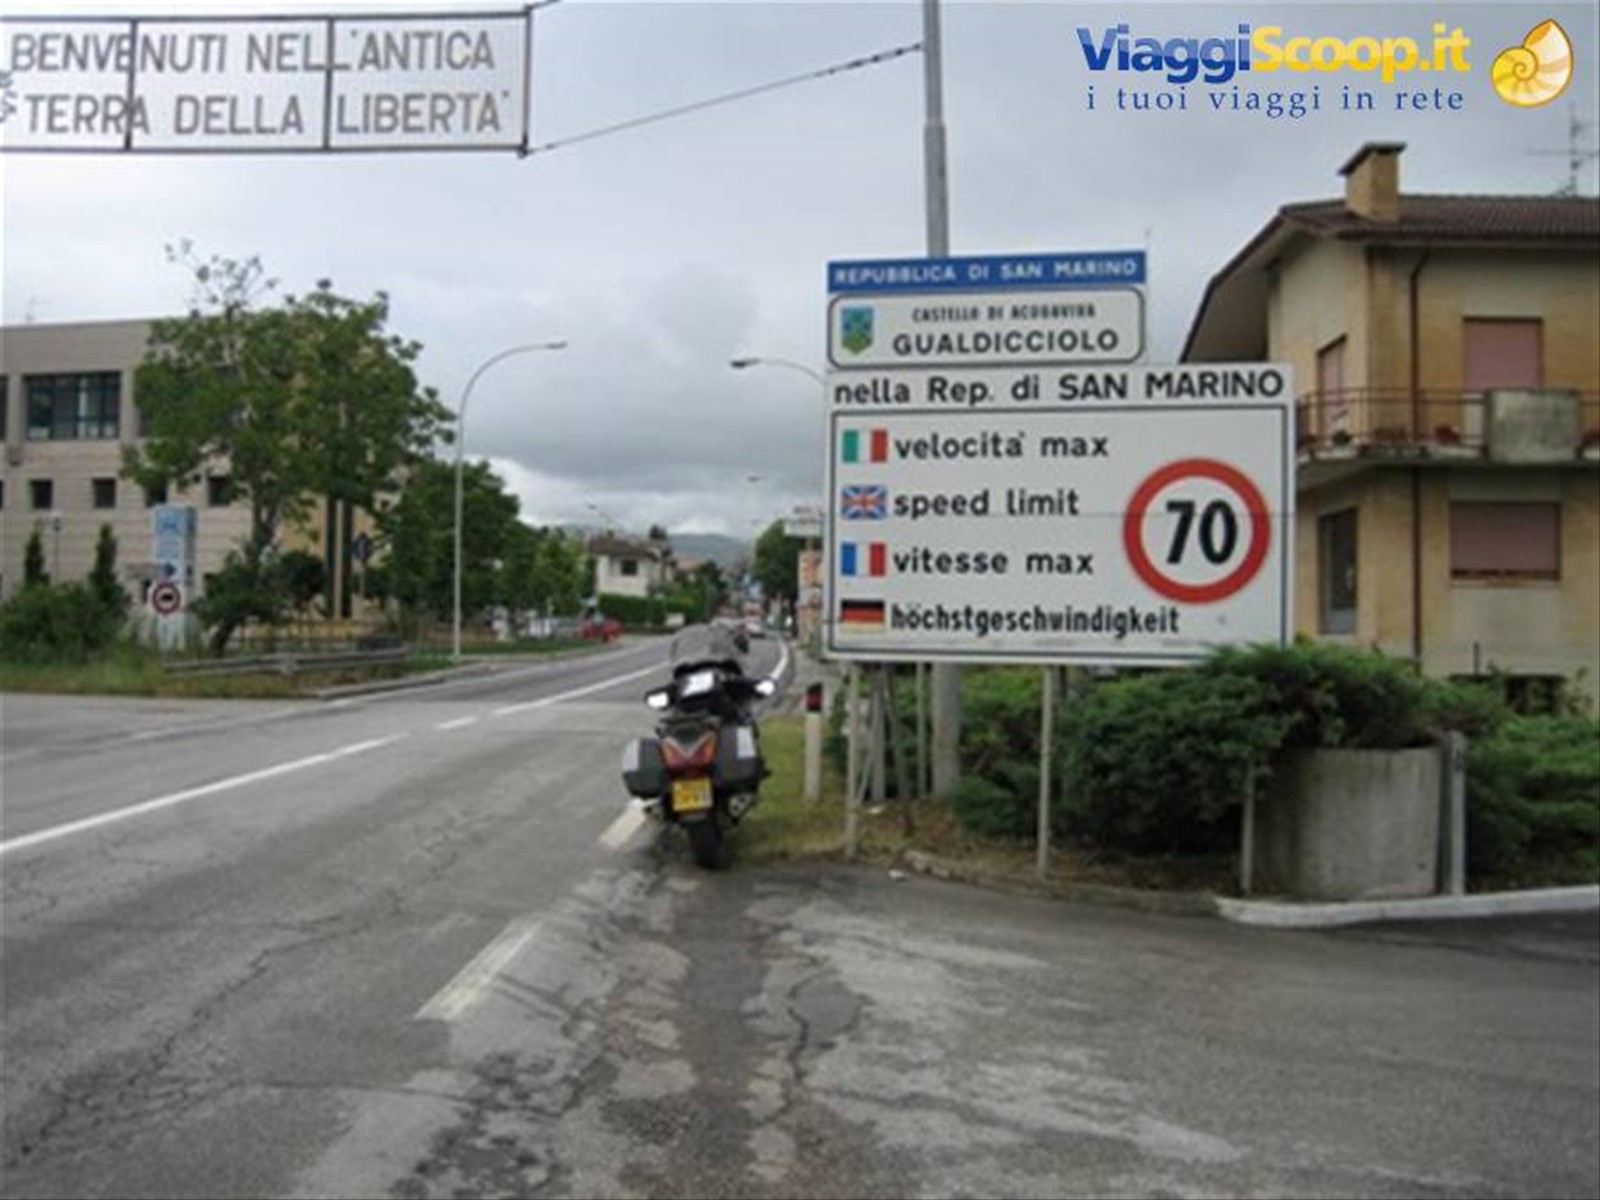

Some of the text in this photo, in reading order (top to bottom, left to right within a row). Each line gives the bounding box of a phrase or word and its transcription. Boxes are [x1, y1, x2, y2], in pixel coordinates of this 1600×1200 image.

[10, 33, 227, 73] BENVENUTI
[24, 94, 150, 134] TERRA
[173, 95, 304, 135] DELLA
[834, 258, 1137, 284] REPUBBLICA DI SAN MARINO
[912, 307, 980, 323] CASTELLO
[987, 305, 1004, 321] DI
[892, 329, 1119, 356] GUALDICCIOLO
[834, 370, 1283, 408] nella Rep. di SAN MARINO
[1040, 437, 1109, 458] max
[893, 489, 1080, 520] speed limit
[1164, 500, 1238, 566] 70
[893, 547, 1094, 575] vitesse max
[890, 605, 1181, 638] höchstgeschwindigkeit
